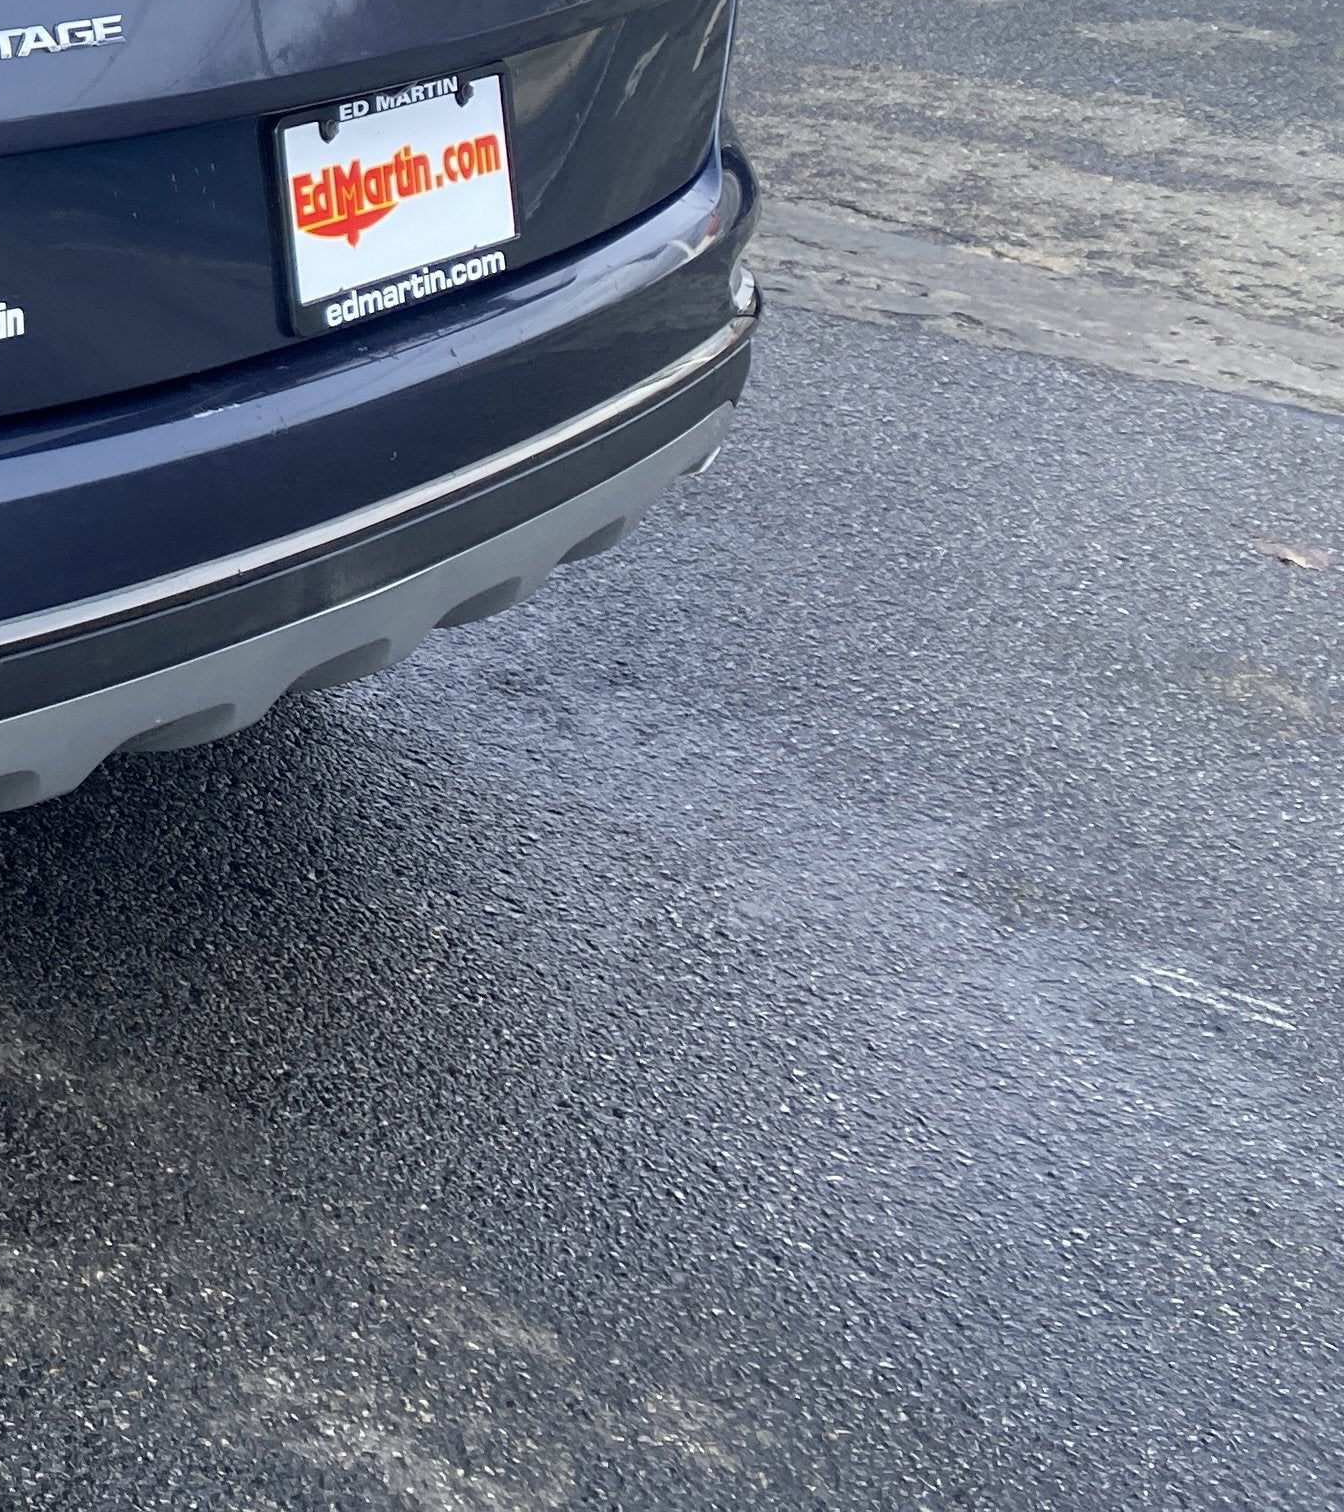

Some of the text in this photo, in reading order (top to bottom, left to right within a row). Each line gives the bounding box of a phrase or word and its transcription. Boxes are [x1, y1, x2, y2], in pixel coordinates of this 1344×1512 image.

[339, 76, 459, 122] ED MARTIN
[291, 133, 502, 232] EdMartin.com
[325, 250, 507, 328] edmartin.com
